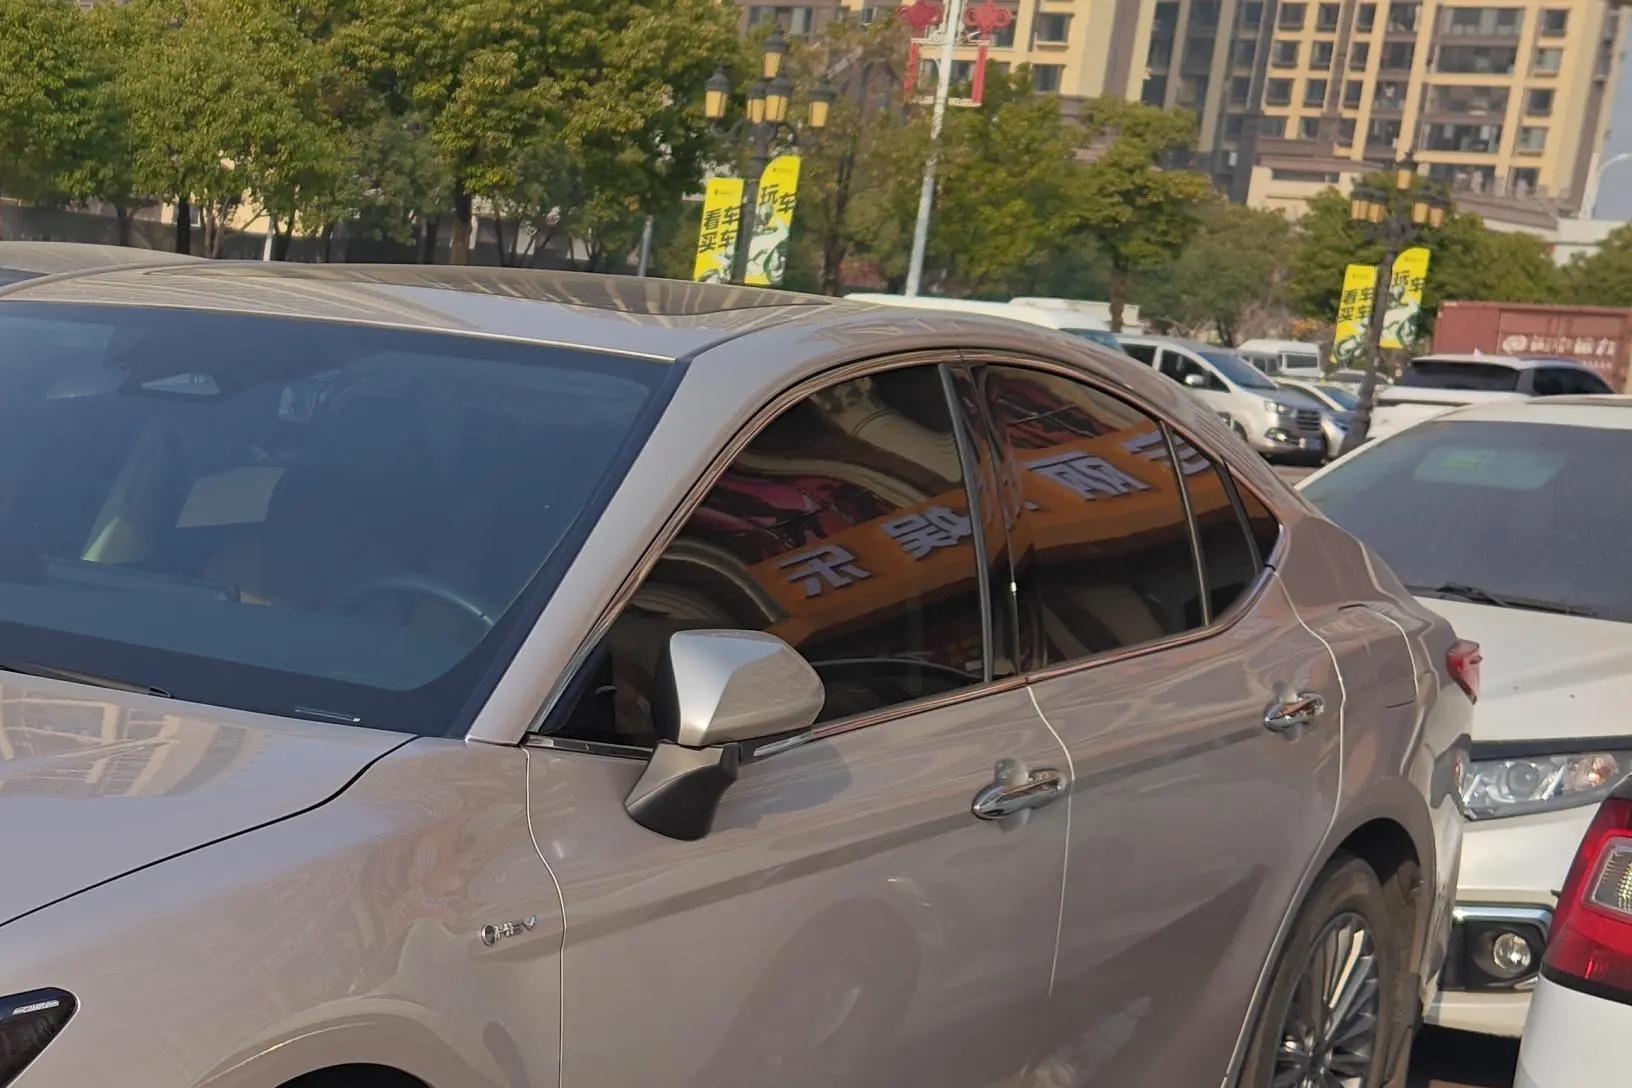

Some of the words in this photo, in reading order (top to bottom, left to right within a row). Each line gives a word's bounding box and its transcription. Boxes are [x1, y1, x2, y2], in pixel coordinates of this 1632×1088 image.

[759, 184, 797, 213] 玩车
[703, 204, 742, 230] 看车
[699, 228, 738, 253] 买车
